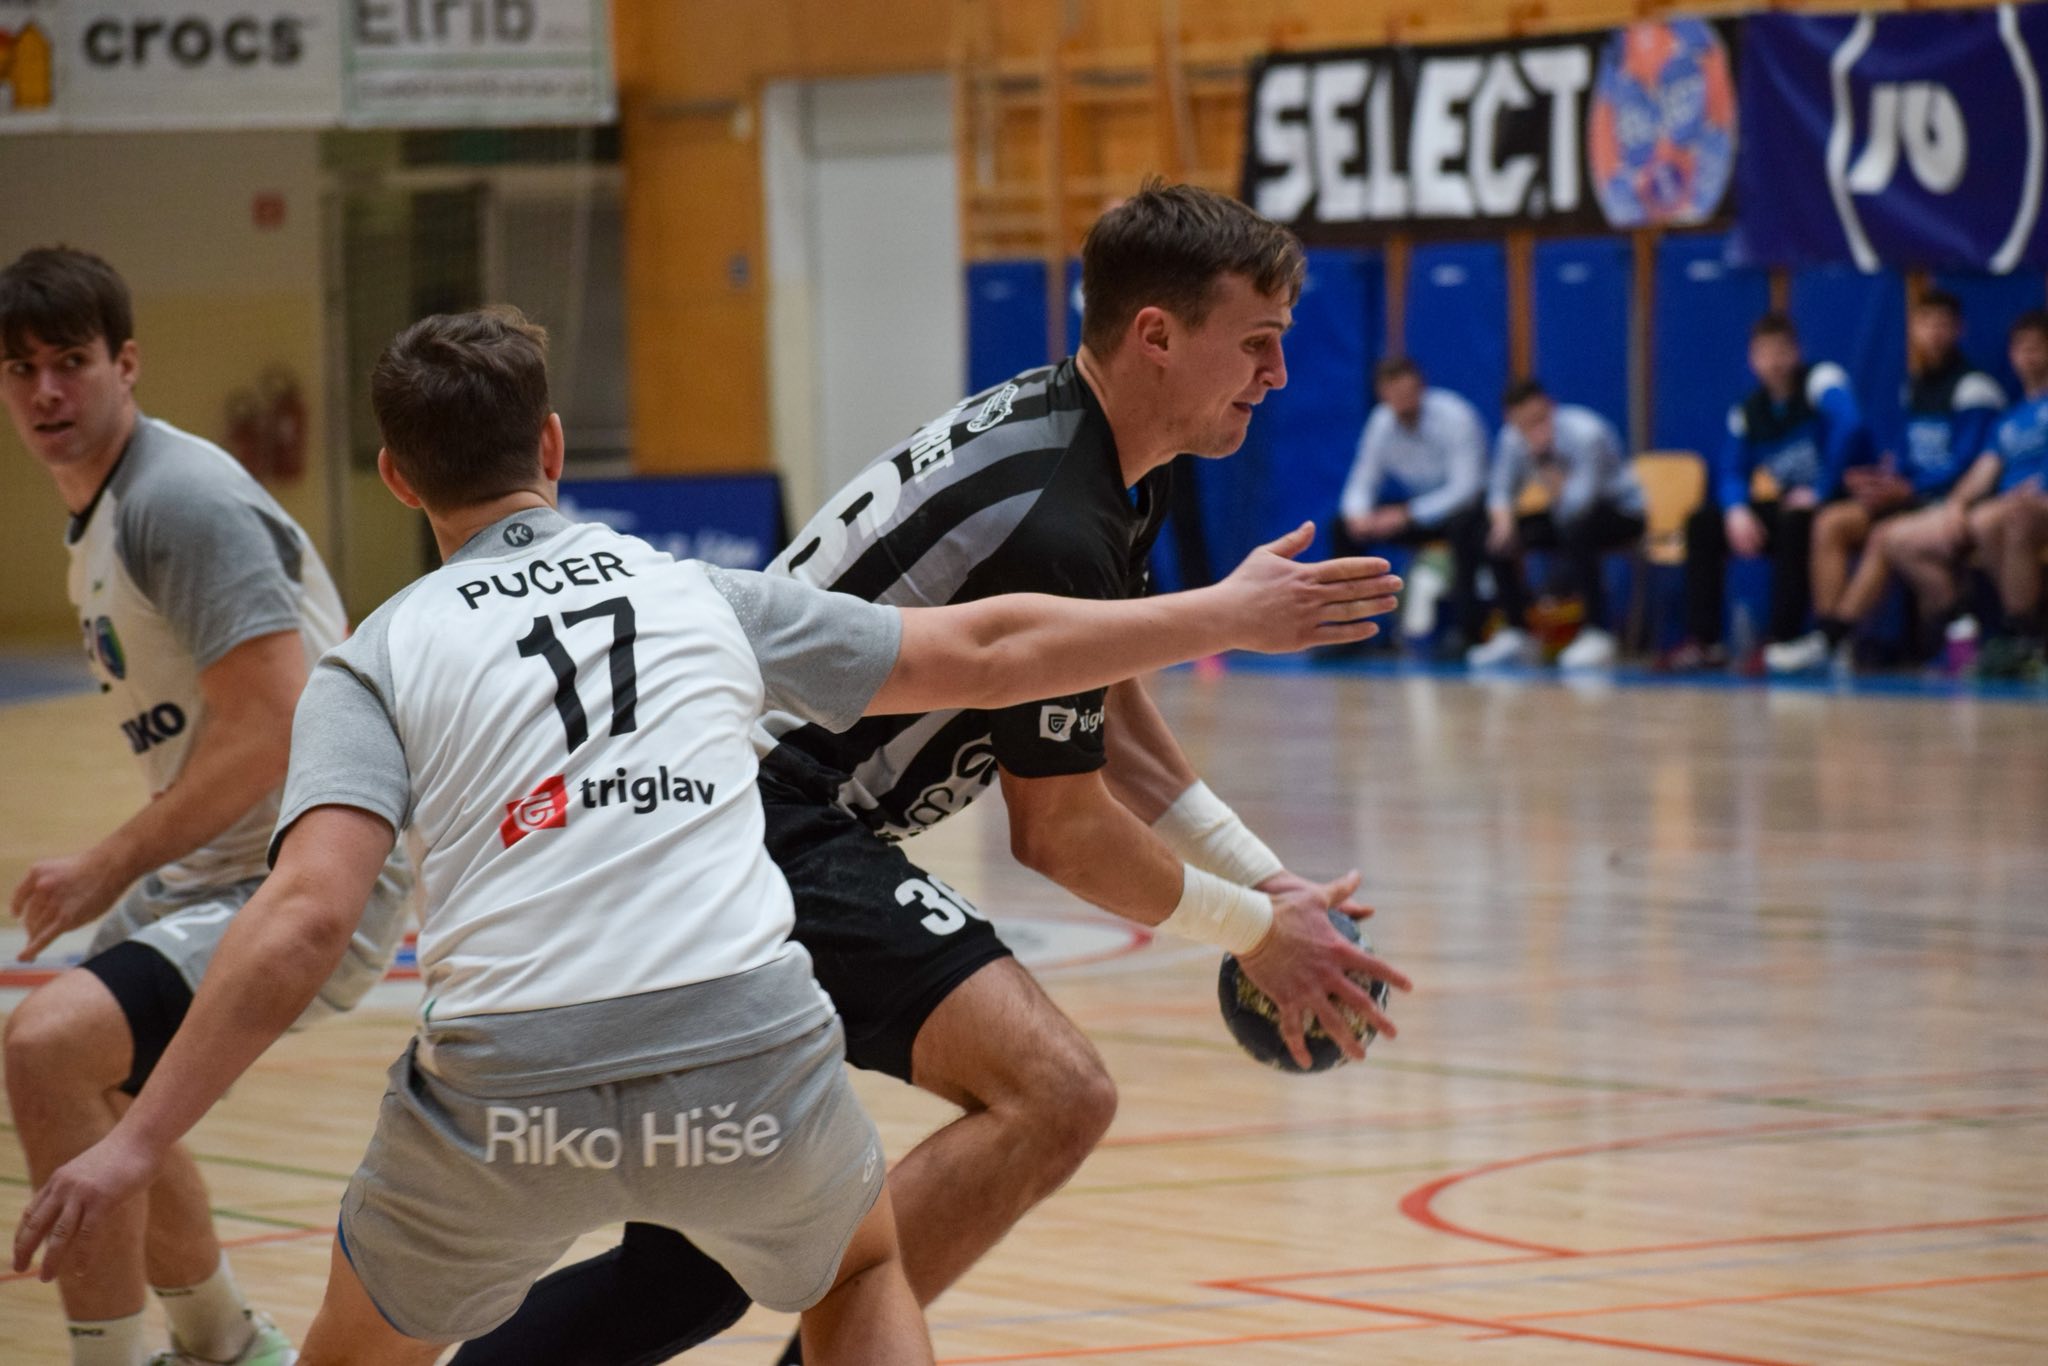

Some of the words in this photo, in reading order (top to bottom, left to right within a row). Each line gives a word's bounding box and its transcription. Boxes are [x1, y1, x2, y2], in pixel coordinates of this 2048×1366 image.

[82, 14, 304, 68] crocs
[1253, 44, 1592, 224] SELECT
[516, 596, 637, 755] 17
[579, 765, 715, 814] triglav
[485, 1105, 623, 1170] Riko
[642, 1101, 782, 1168] Hiše
